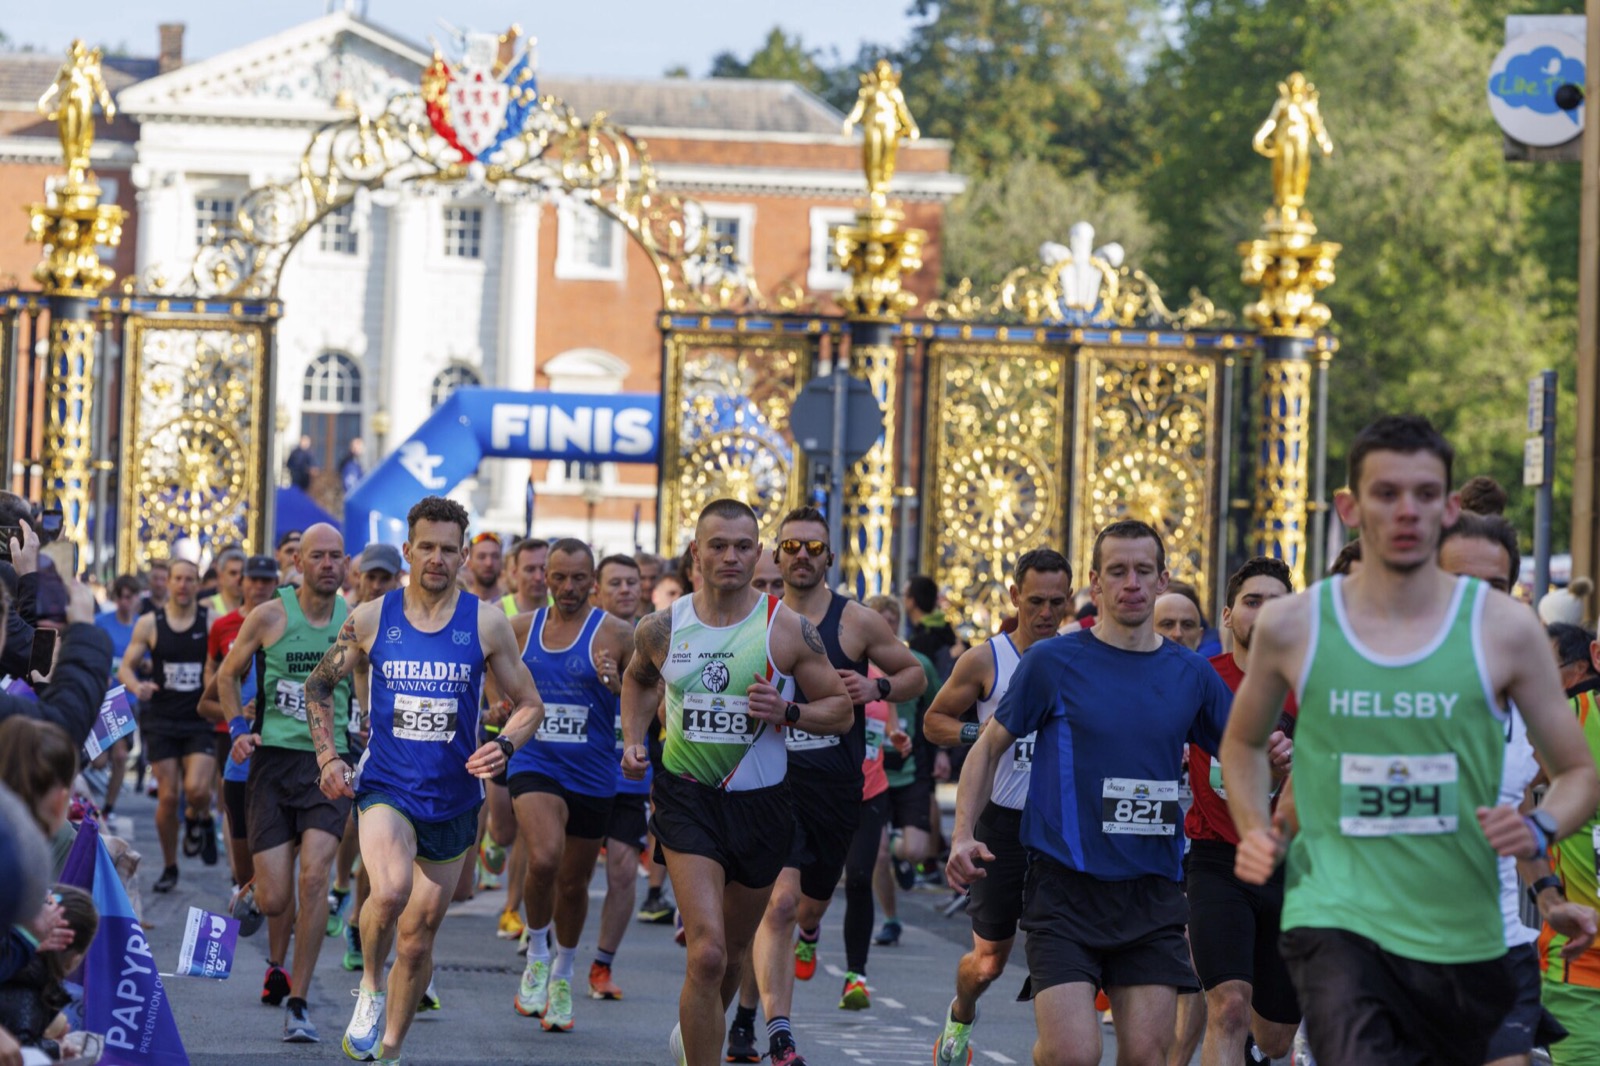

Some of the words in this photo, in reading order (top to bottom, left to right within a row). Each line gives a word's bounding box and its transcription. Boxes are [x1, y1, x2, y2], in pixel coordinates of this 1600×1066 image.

[491, 403, 655, 456] FINIS
[286, 651, 325, 663] BRAM
[289, 662, 318, 674] RUN
[382, 660, 472, 682] CHEADLE
[386, 680, 437, 693] RUNNING
[439, 681, 468, 693] CLUB
[1329, 689, 1459, 718] HELSBY
[402, 711, 449, 732] 969
[537, 717, 586, 735] 1647
[688, 710, 748, 734] 1198
[785, 726, 835, 742] 16
[1017, 742, 1035, 762] 1
[1358, 784, 1441, 817] 394
[1114, 799, 1164, 824] 821
[140, 991, 162, 1053] PREVENTION
